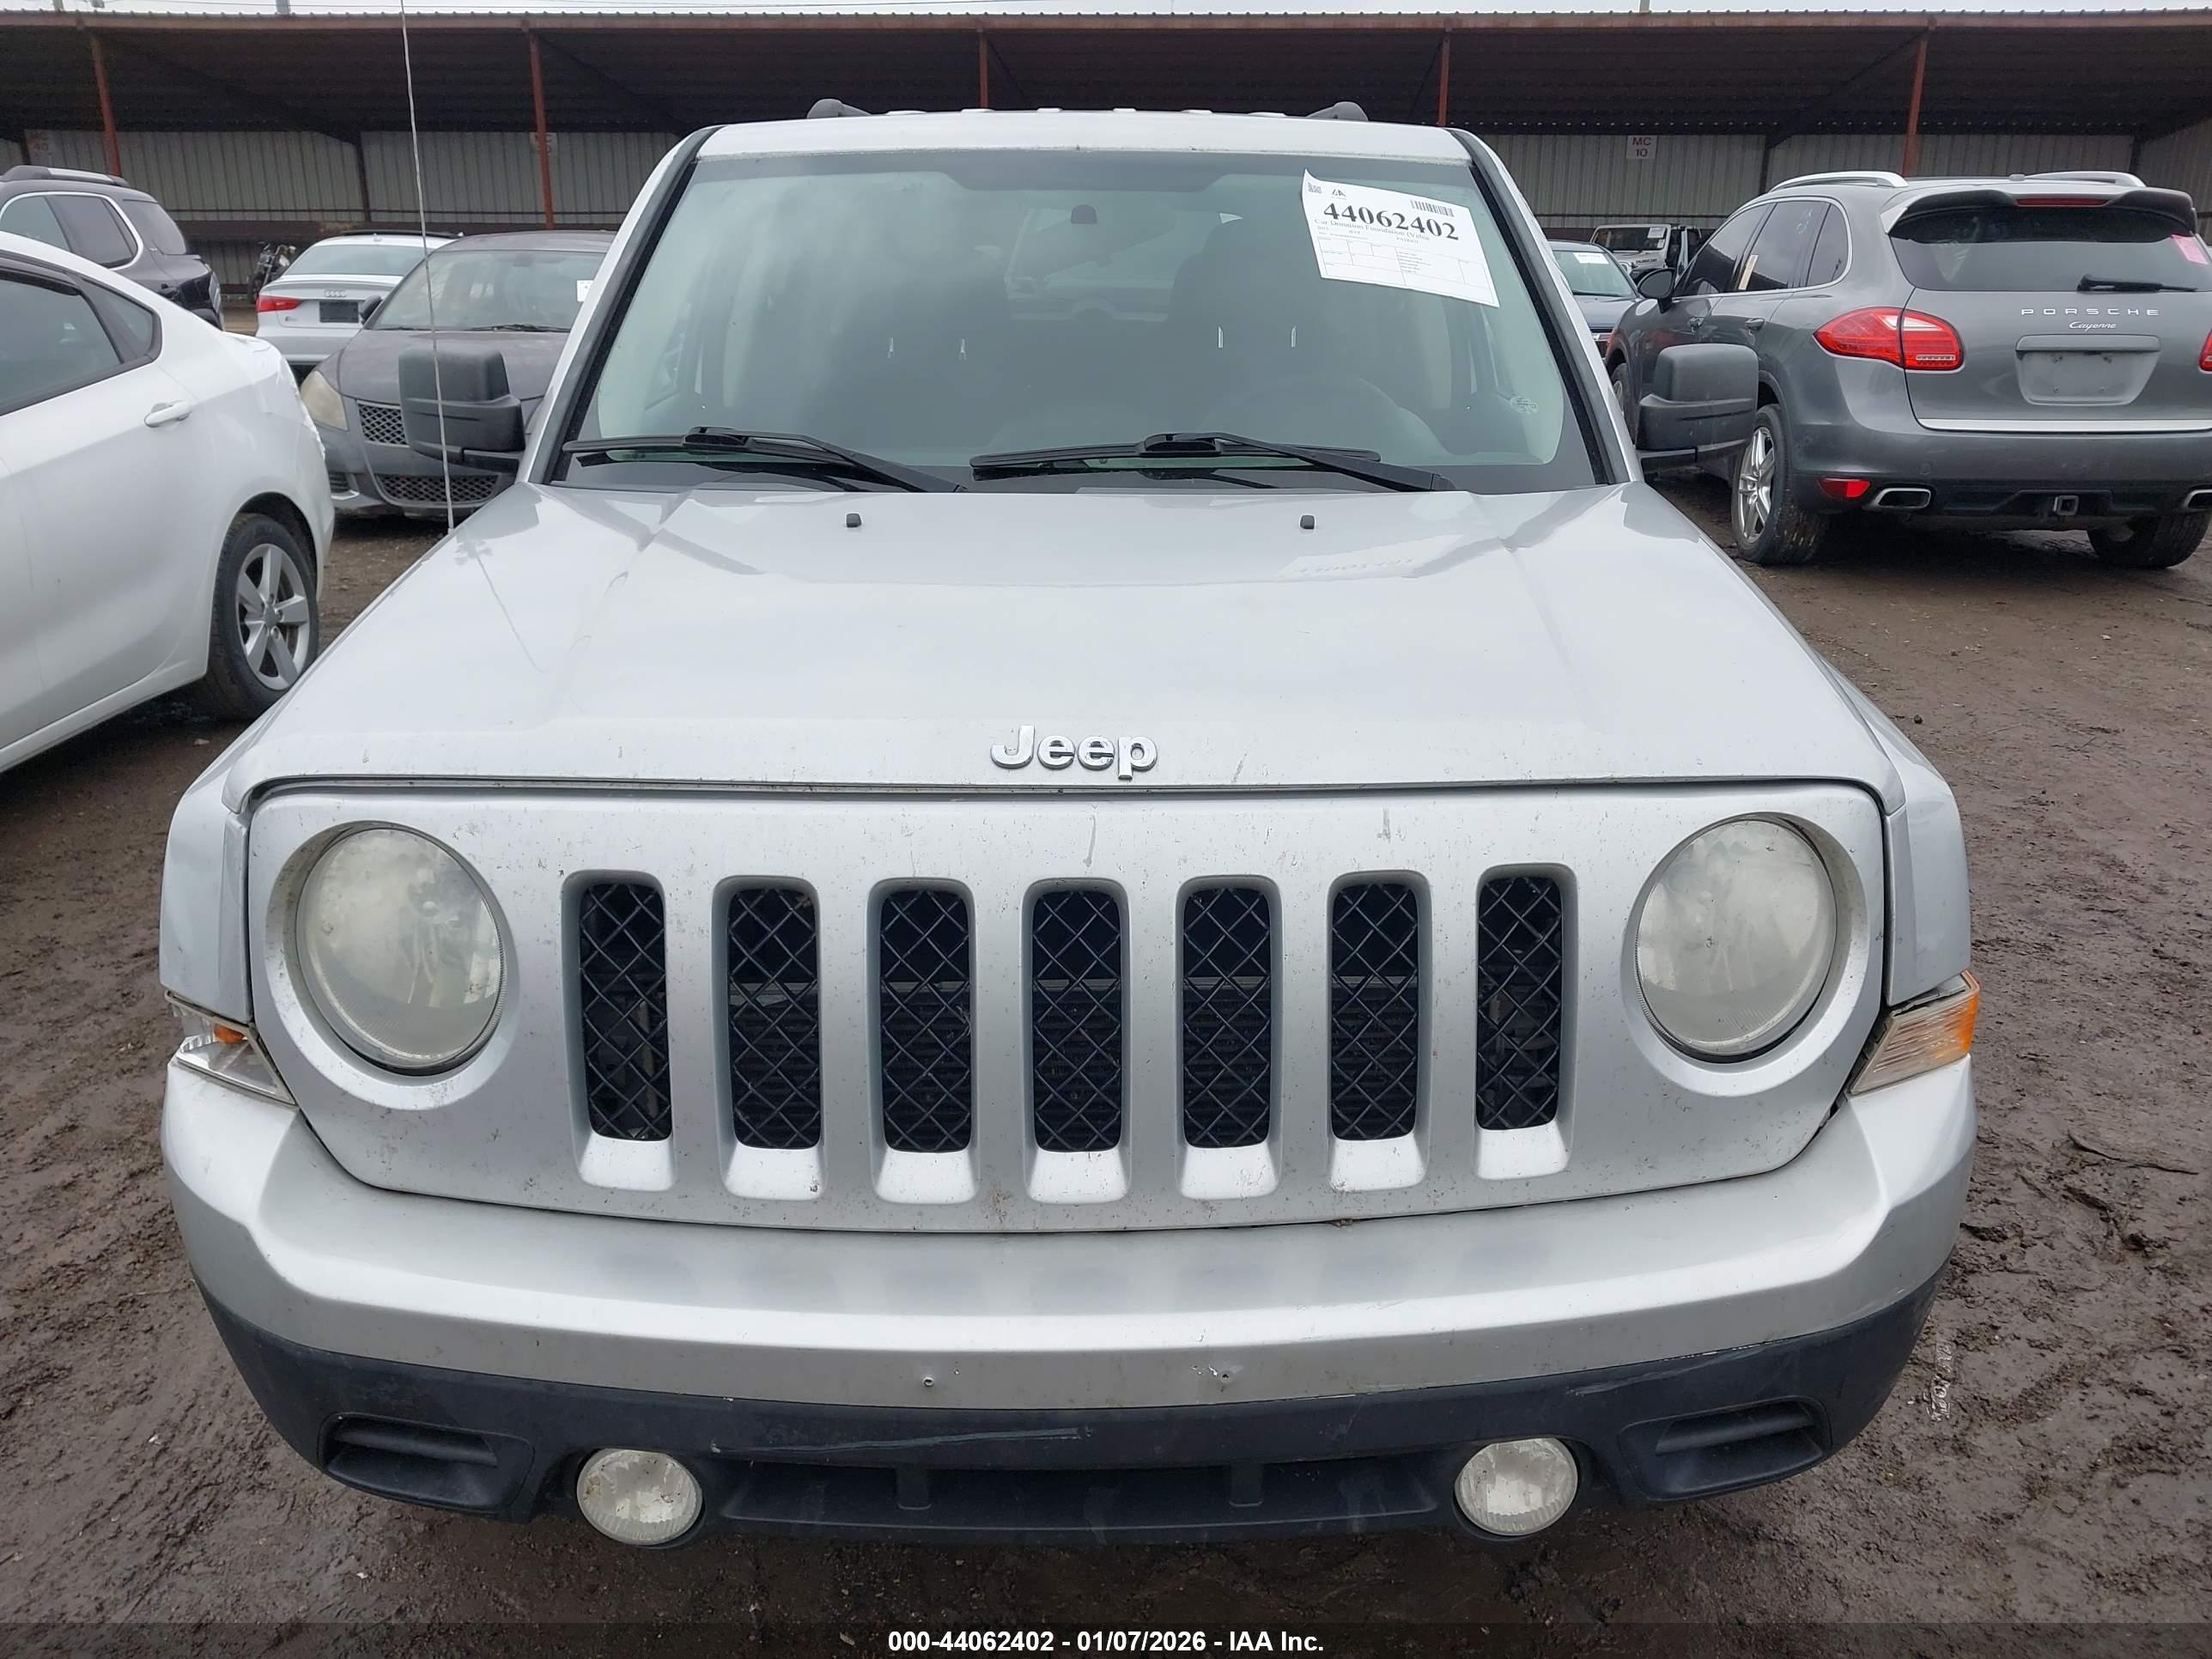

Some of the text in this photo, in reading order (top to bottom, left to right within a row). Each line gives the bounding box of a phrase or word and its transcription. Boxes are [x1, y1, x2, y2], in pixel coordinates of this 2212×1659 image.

[1632, 137, 1651, 146] MC
[1636, 149, 1648, 157] 10
[1323, 203, 1459, 240] 44062402
[2069, 321, 2117, 331] Cayenne
[990, 725, 1158, 781] Jeep
